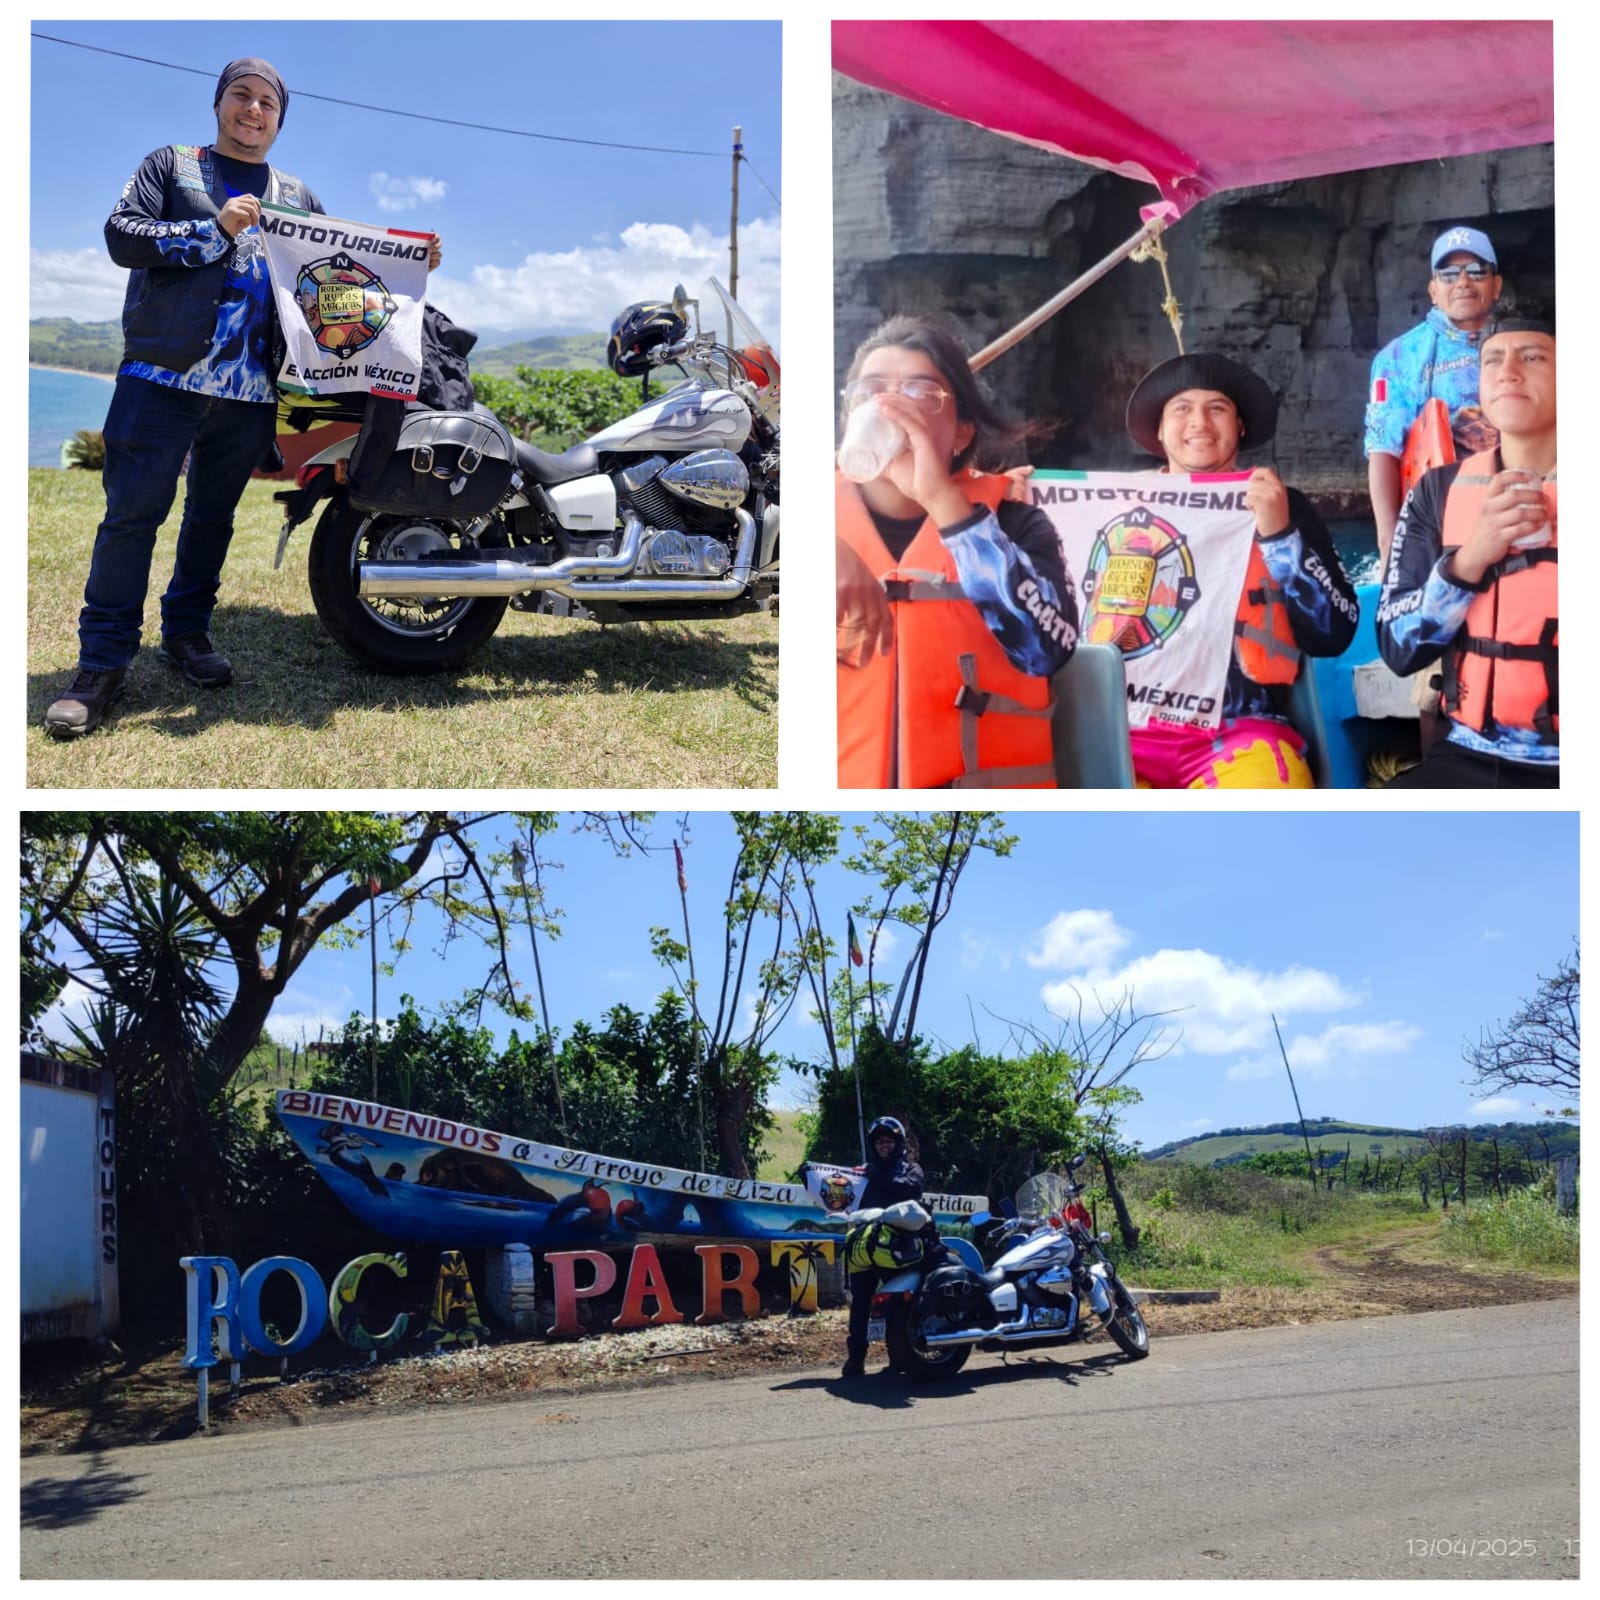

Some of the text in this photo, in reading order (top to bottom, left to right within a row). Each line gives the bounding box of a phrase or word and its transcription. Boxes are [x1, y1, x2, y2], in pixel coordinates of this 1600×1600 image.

[259, 214, 428, 261] MOTOTURISMO
[336, 257, 348, 267] N
[285, 364, 299, 378] E
[303, 361, 358, 381] ACCIÓN
[1130, 512, 1147, 523] N
[1180, 586, 1197, 600] E
[1017, 579, 1077, 651] CUATR
[1126, 682, 1216, 714] MÉXICO
[281, 1091, 503, 1153] BIENVENIDOS
[554, 1149, 666, 1187] Arroyo
[681, 1172, 711, 1192] de
[722, 1178, 799, 1204] Liza
[101, 1107, 117, 1265] TOURS
[180, 1250, 490, 1368] ROCA
